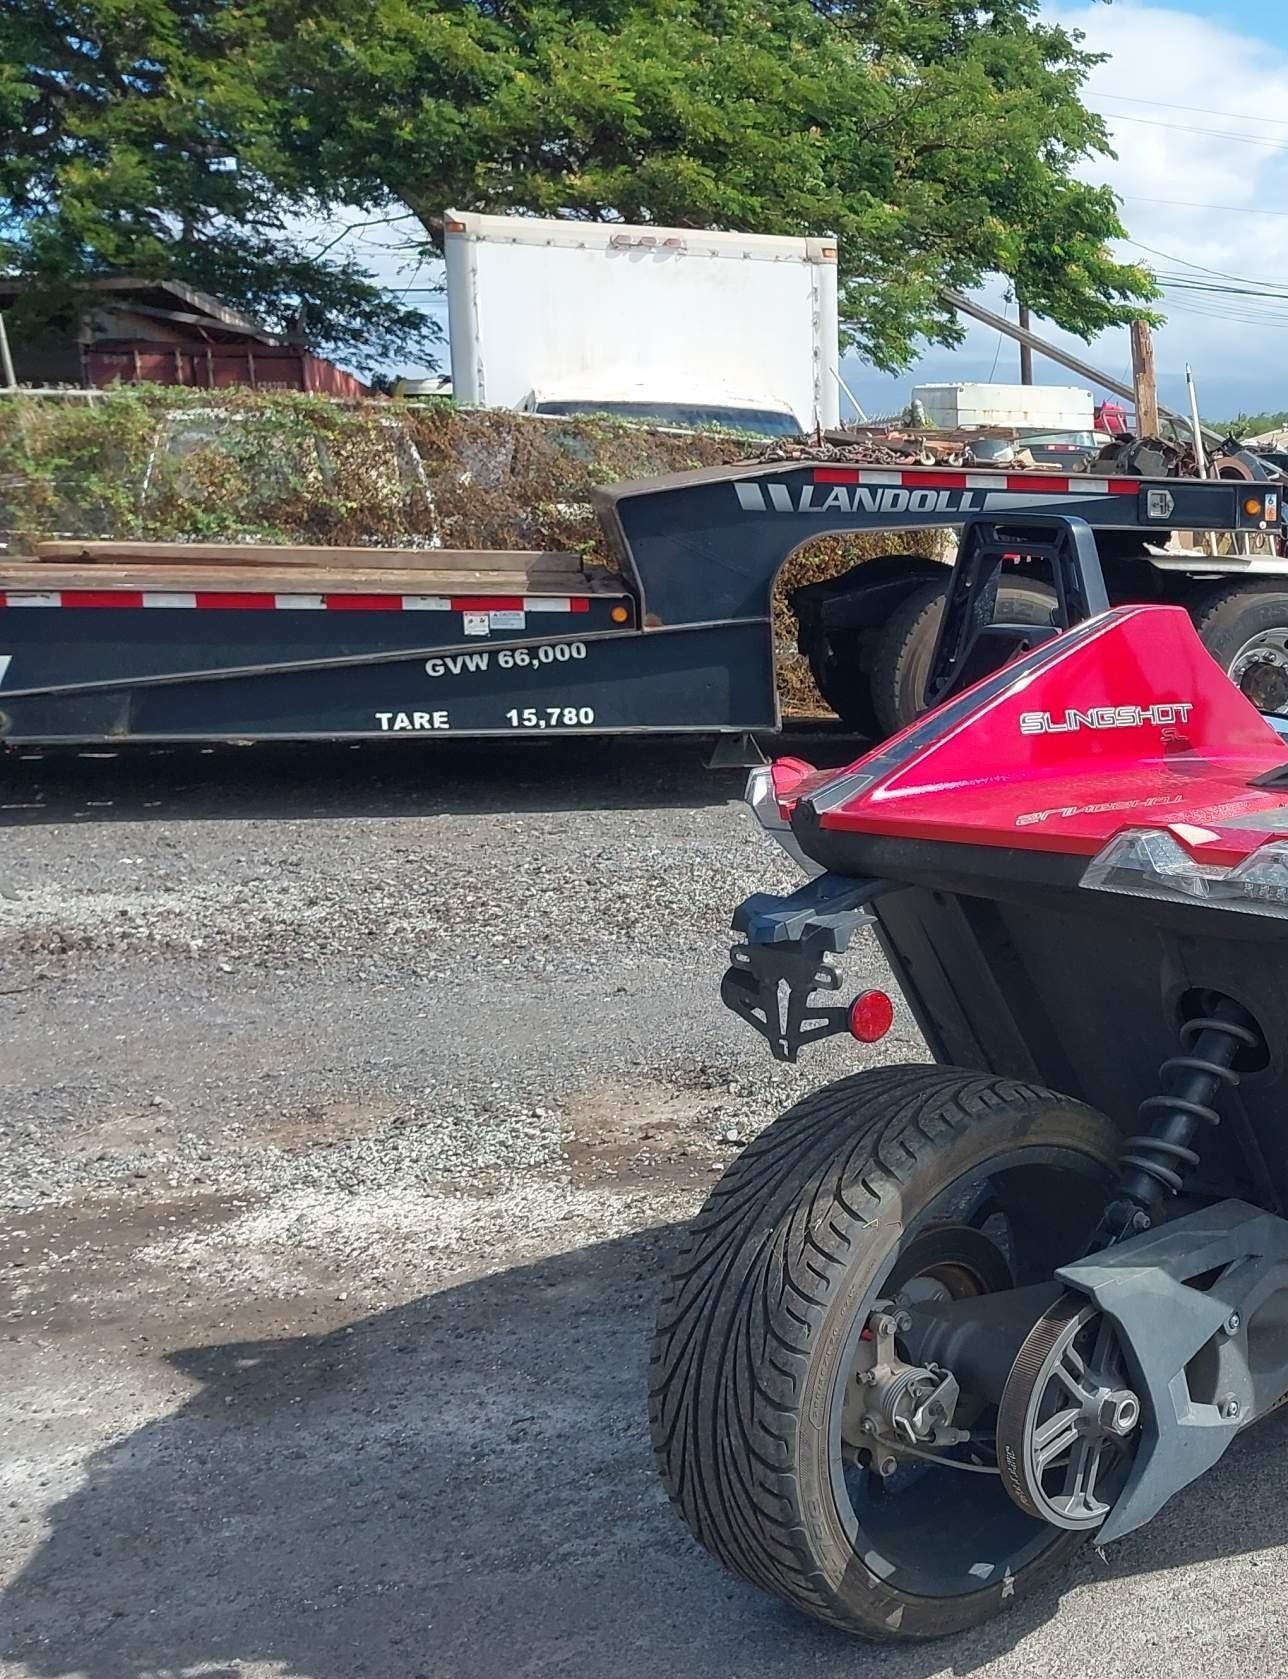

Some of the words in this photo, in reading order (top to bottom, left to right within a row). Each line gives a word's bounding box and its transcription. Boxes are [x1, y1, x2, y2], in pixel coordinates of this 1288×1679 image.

[797, 485, 982, 513] LANDOLL
[425, 653, 489, 677] GVW
[498, 642, 587, 669] 66,000
[375, 711, 450, 731] TARE
[506, 707, 595, 729] 15,780
[1019, 703, 1193, 735] SLINGSHOT
[1160, 727, 1189, 743] SL
